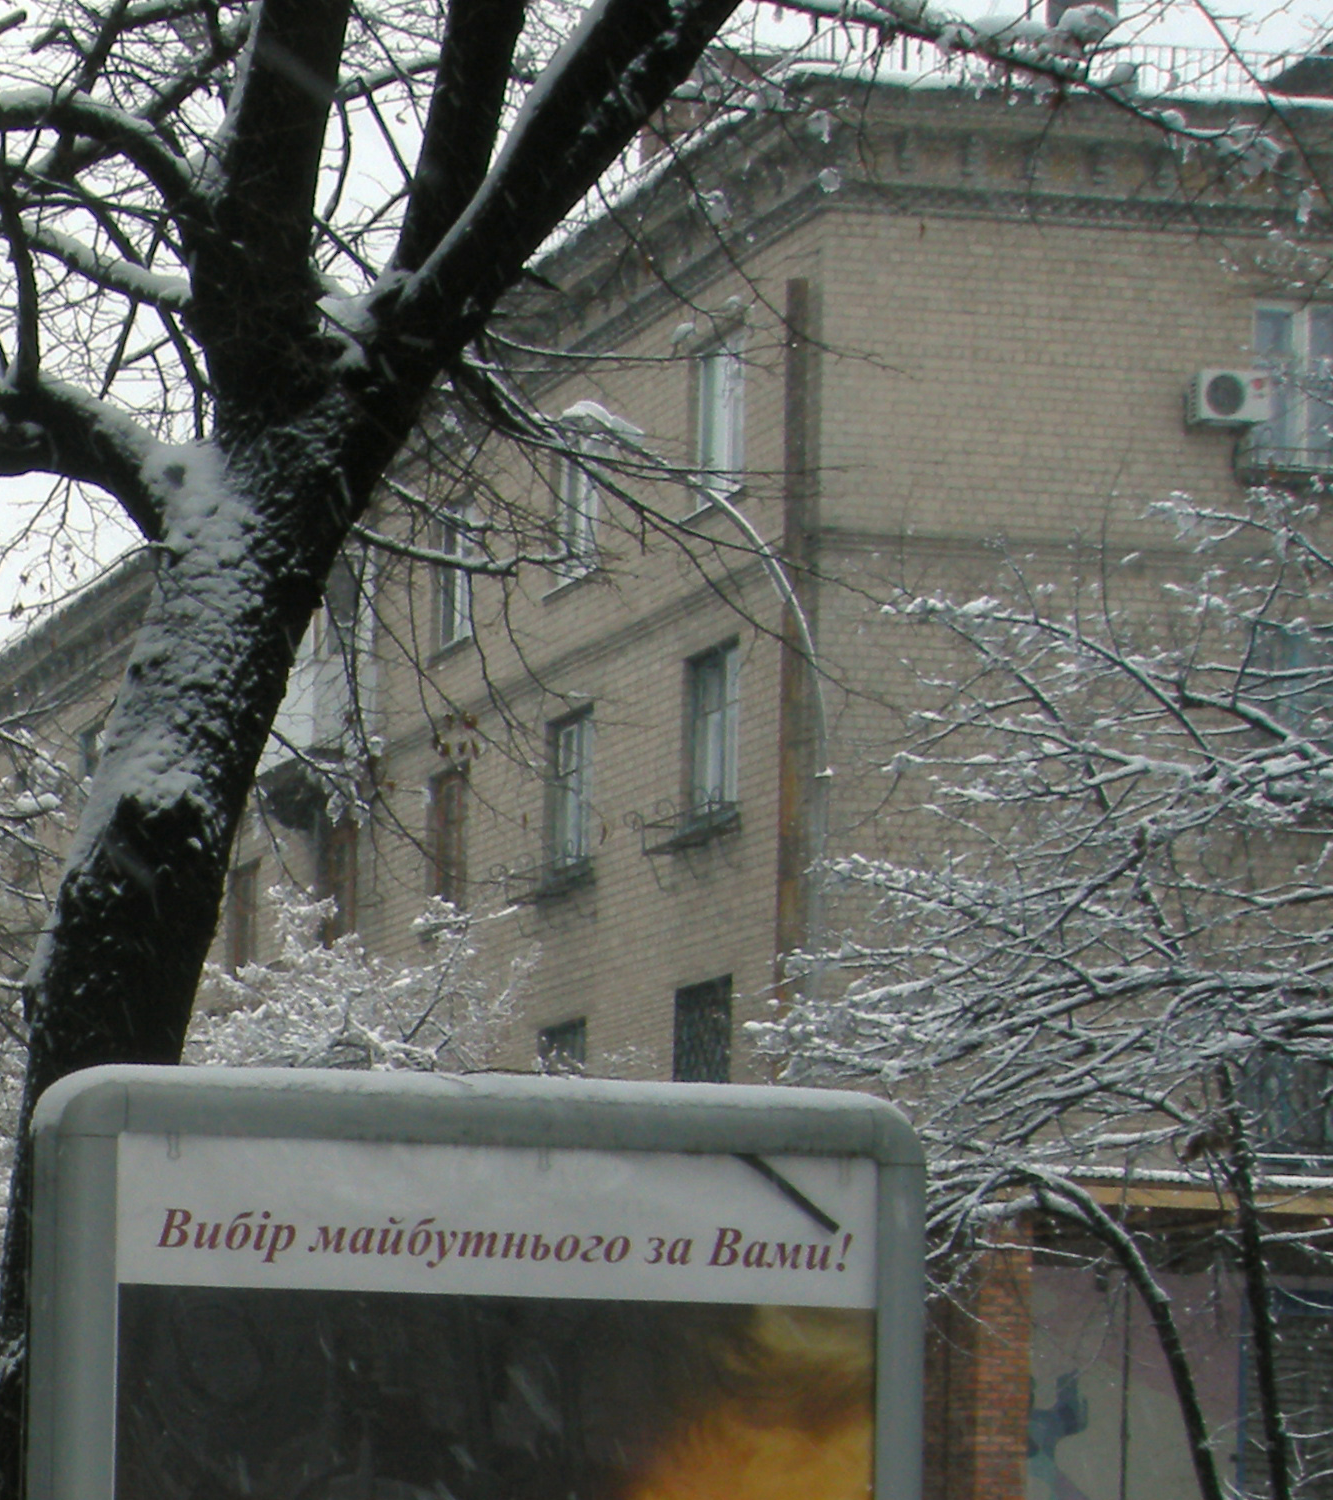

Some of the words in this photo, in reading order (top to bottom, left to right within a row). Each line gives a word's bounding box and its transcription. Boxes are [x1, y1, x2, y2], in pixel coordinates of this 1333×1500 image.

[157, 1208, 296, 1263] Вибір
[307, 1216, 632, 1269] майбутнього
[644, 1235, 694, 1266] за
[706, 1226, 854, 1273] Вами!
